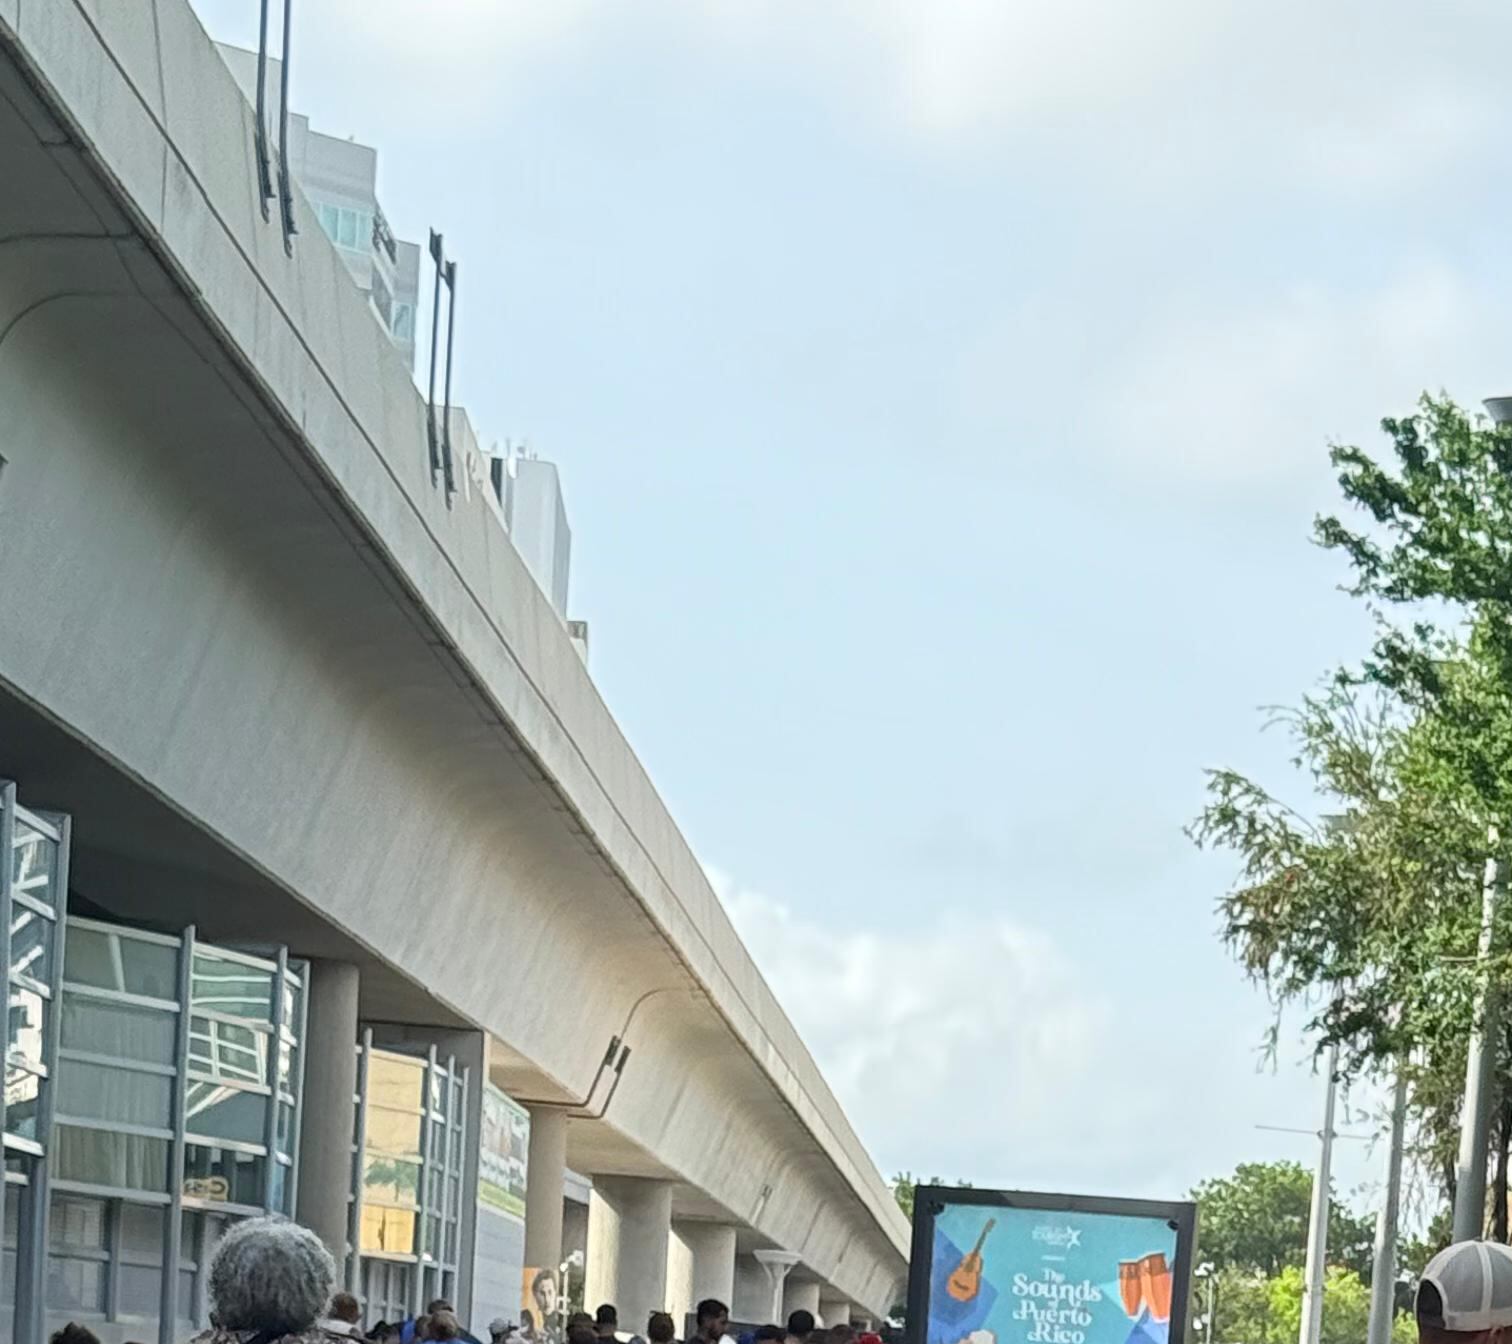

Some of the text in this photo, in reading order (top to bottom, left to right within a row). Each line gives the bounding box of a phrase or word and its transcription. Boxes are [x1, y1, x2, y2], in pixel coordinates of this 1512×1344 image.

[1012, 1273, 1102, 1307] Sounds
[1012, 1299, 1092, 1327] Puerto
[1026, 1321, 1085, 1344] Rico
